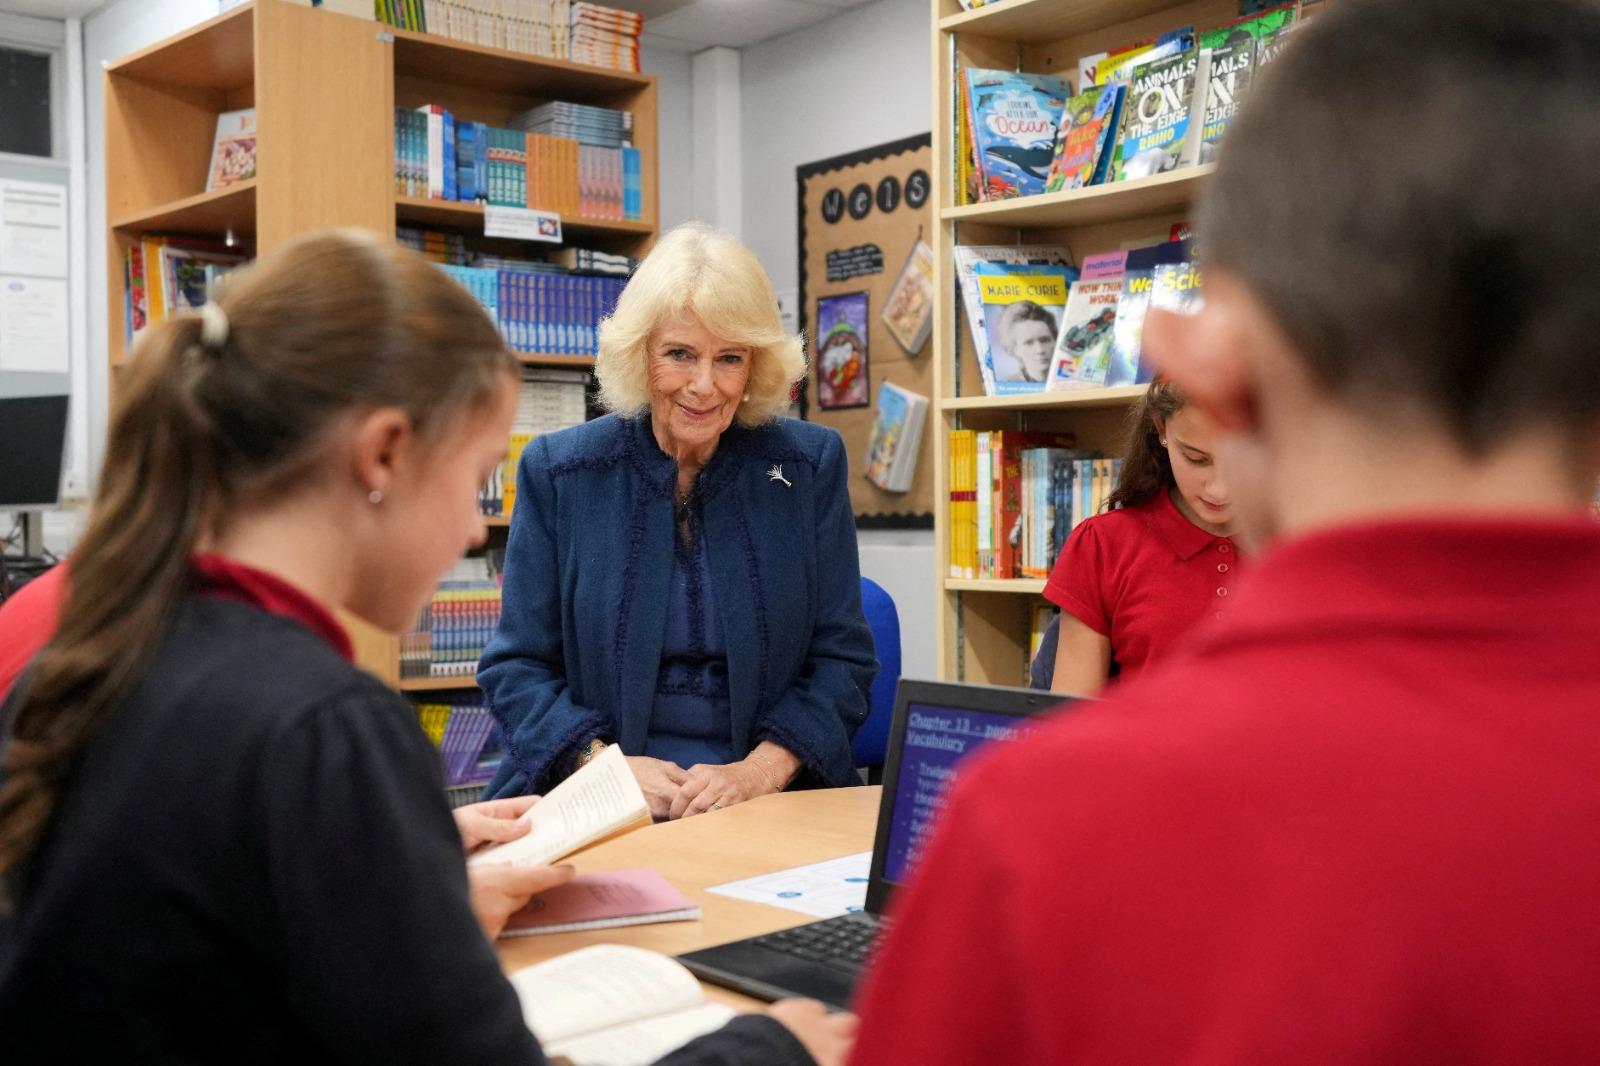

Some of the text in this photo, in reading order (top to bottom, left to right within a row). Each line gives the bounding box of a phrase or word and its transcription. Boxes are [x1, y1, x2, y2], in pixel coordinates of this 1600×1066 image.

[1133, 58, 1196, 95] ANIMALS
[1007, 101, 1032, 110] LOOKING
[1138, 78, 1184, 123] ON
[994, 115, 1049, 135] Ocean
[1006, 110, 1026, 119] AFTER
[1130, 106, 1188, 139] THE EDGE
[1139, 127, 1175, 150] RHINO
[1086, 258, 1123, 271] material
[987, 284, 1060, 296] MARIE CURIE
[1078, 283, 1099, 295] HOW
[909, 712, 952, 731] Chapter
[956, 717, 970, 733] 13
[985, 723, 1019, 741] pages
[906, 730, 966, 753] Vocabulary
